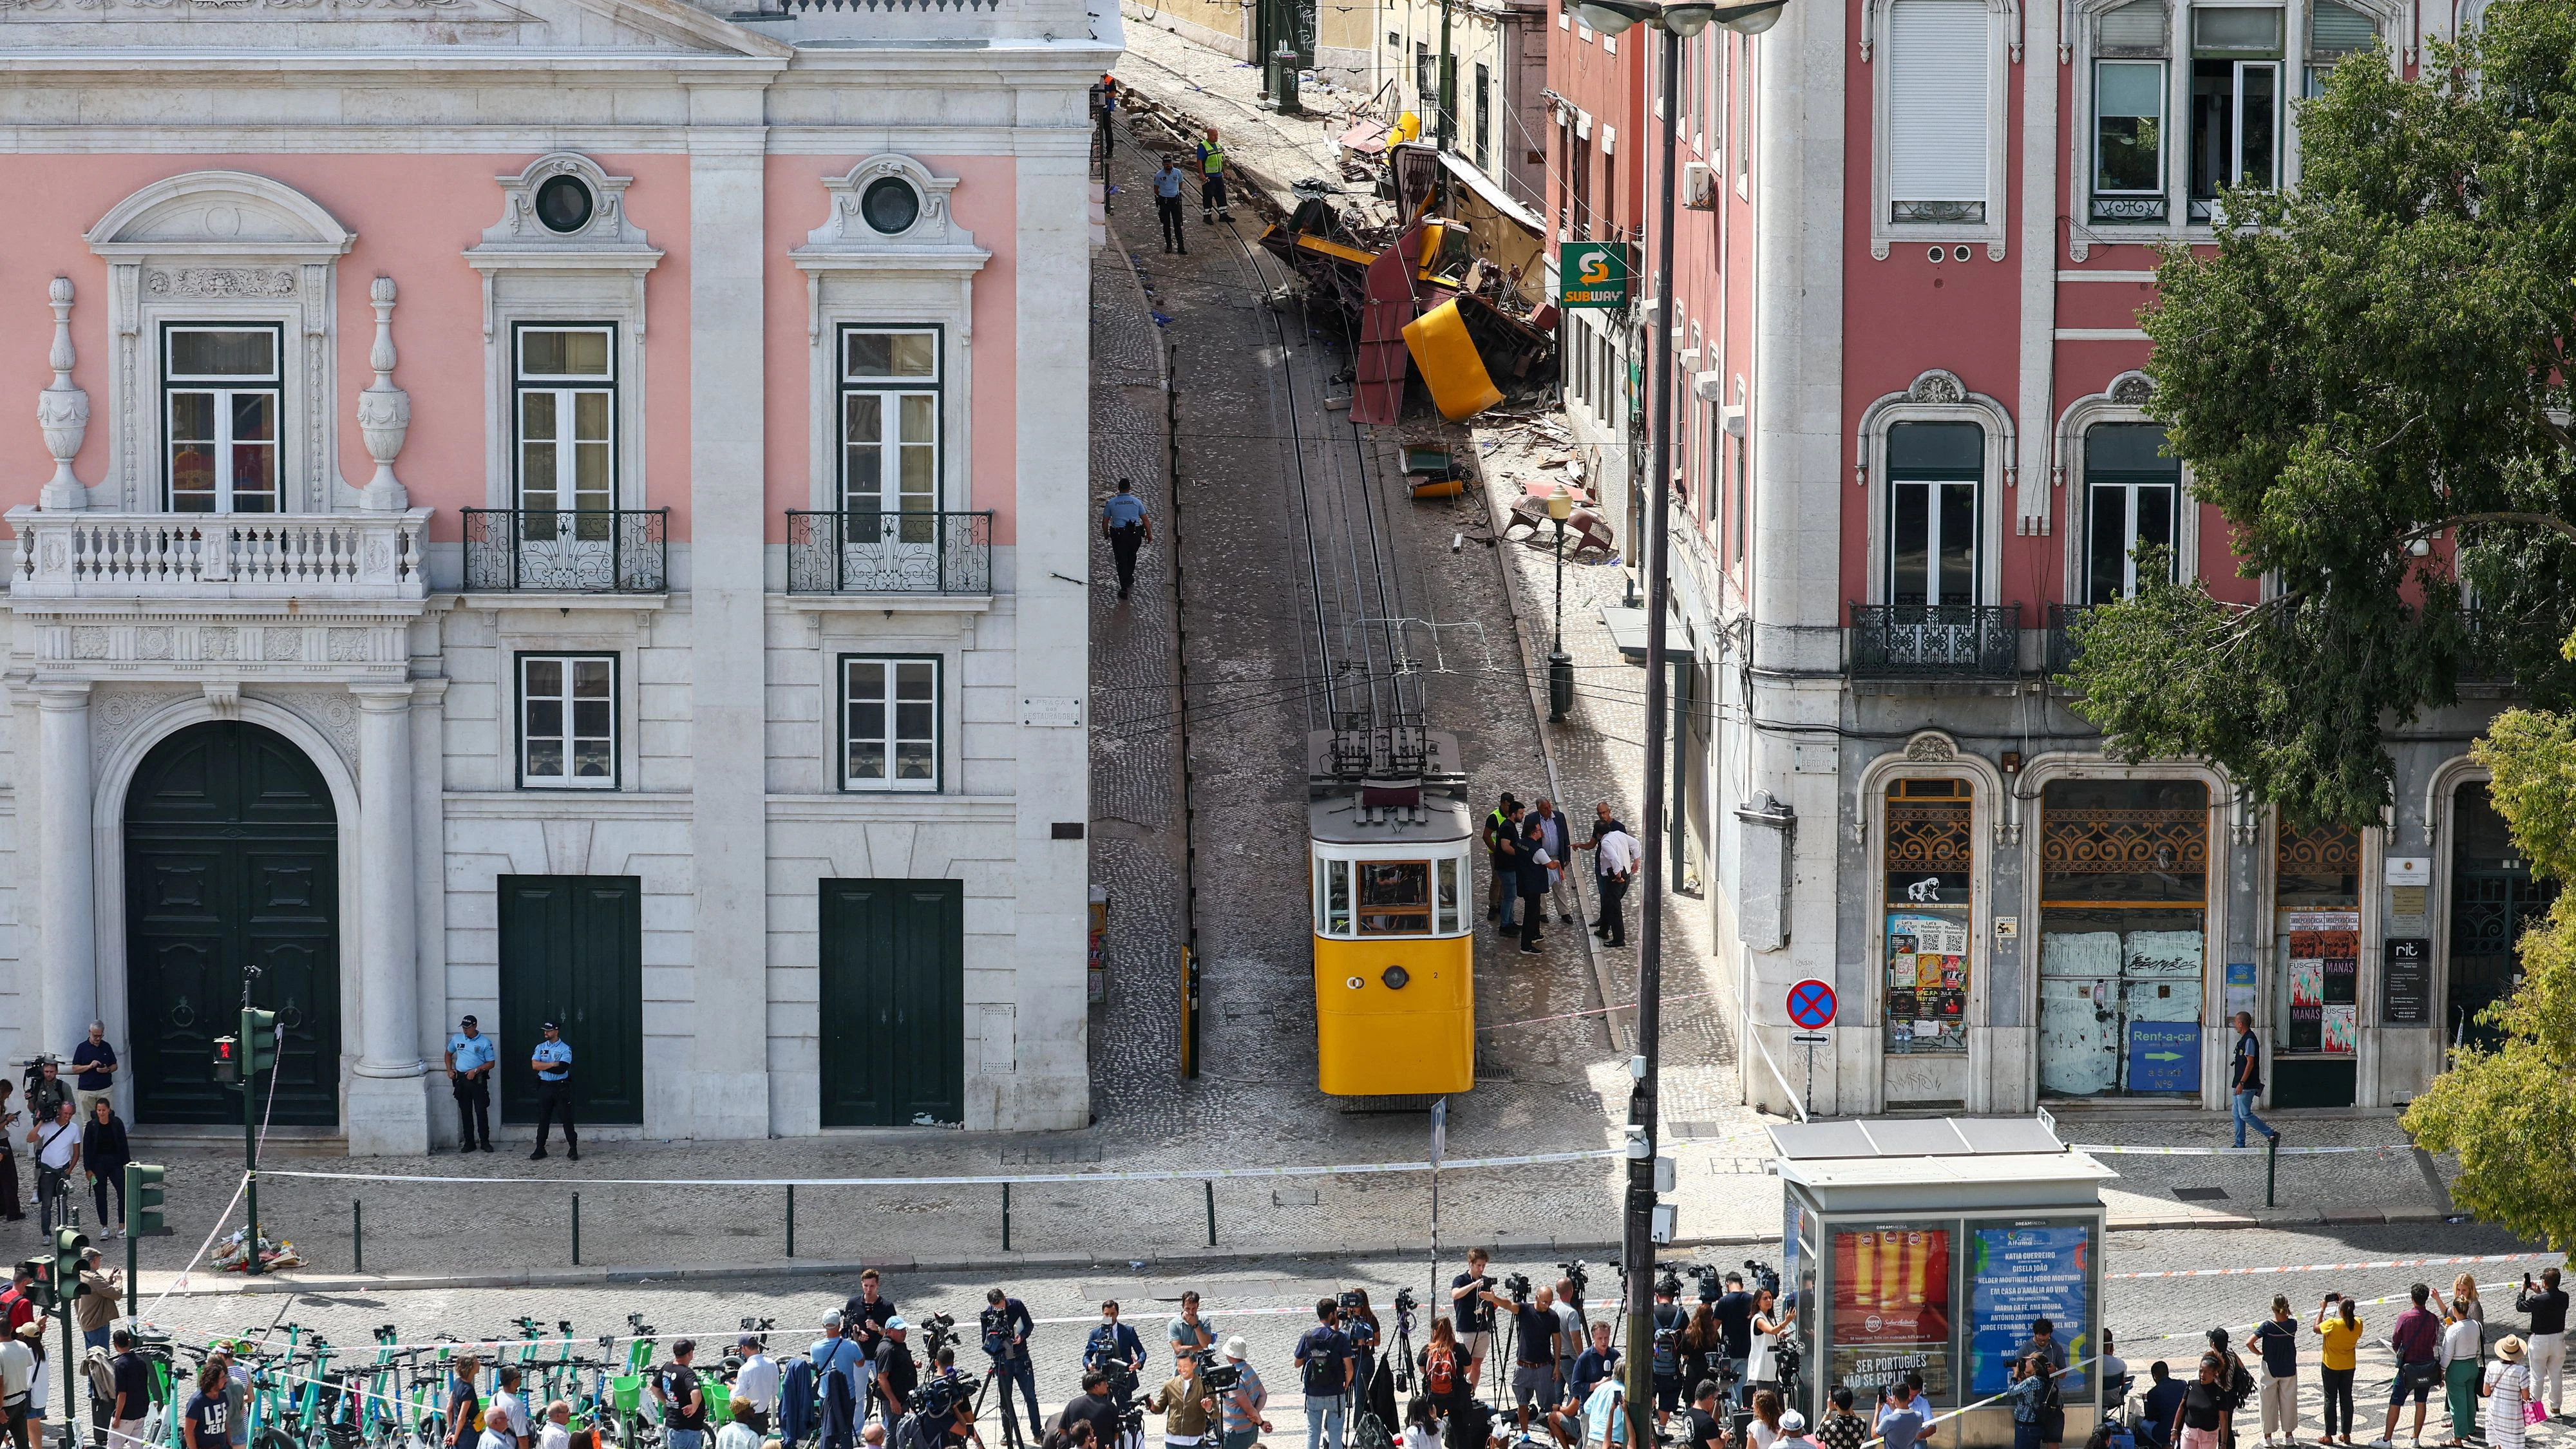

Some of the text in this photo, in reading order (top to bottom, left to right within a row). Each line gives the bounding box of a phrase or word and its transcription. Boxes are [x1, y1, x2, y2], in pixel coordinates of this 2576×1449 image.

[1564, 290, 1624, 303] SUBWAY
[2396, 942, 2418, 956] rit
[2326, 962, 2354, 973] MANAS
[2293, 1009, 2320, 1019] MANAS
[2134, 1031, 2197, 1041] Rent-a-car
[1435, 1107, 1443, 1144] P
[2023, 1251, 2056, 1260] GUERREIRO
[2033, 1264, 2048, 1273] JOÃO
[2017, 1285, 2045, 1294] D'AMÁLIA
[1857, 1351, 1927, 1373] SER PORTUGUÊS
[1843, 1372, 1861, 1388] NÃO
[1864, 1374, 1874, 1387] SE
